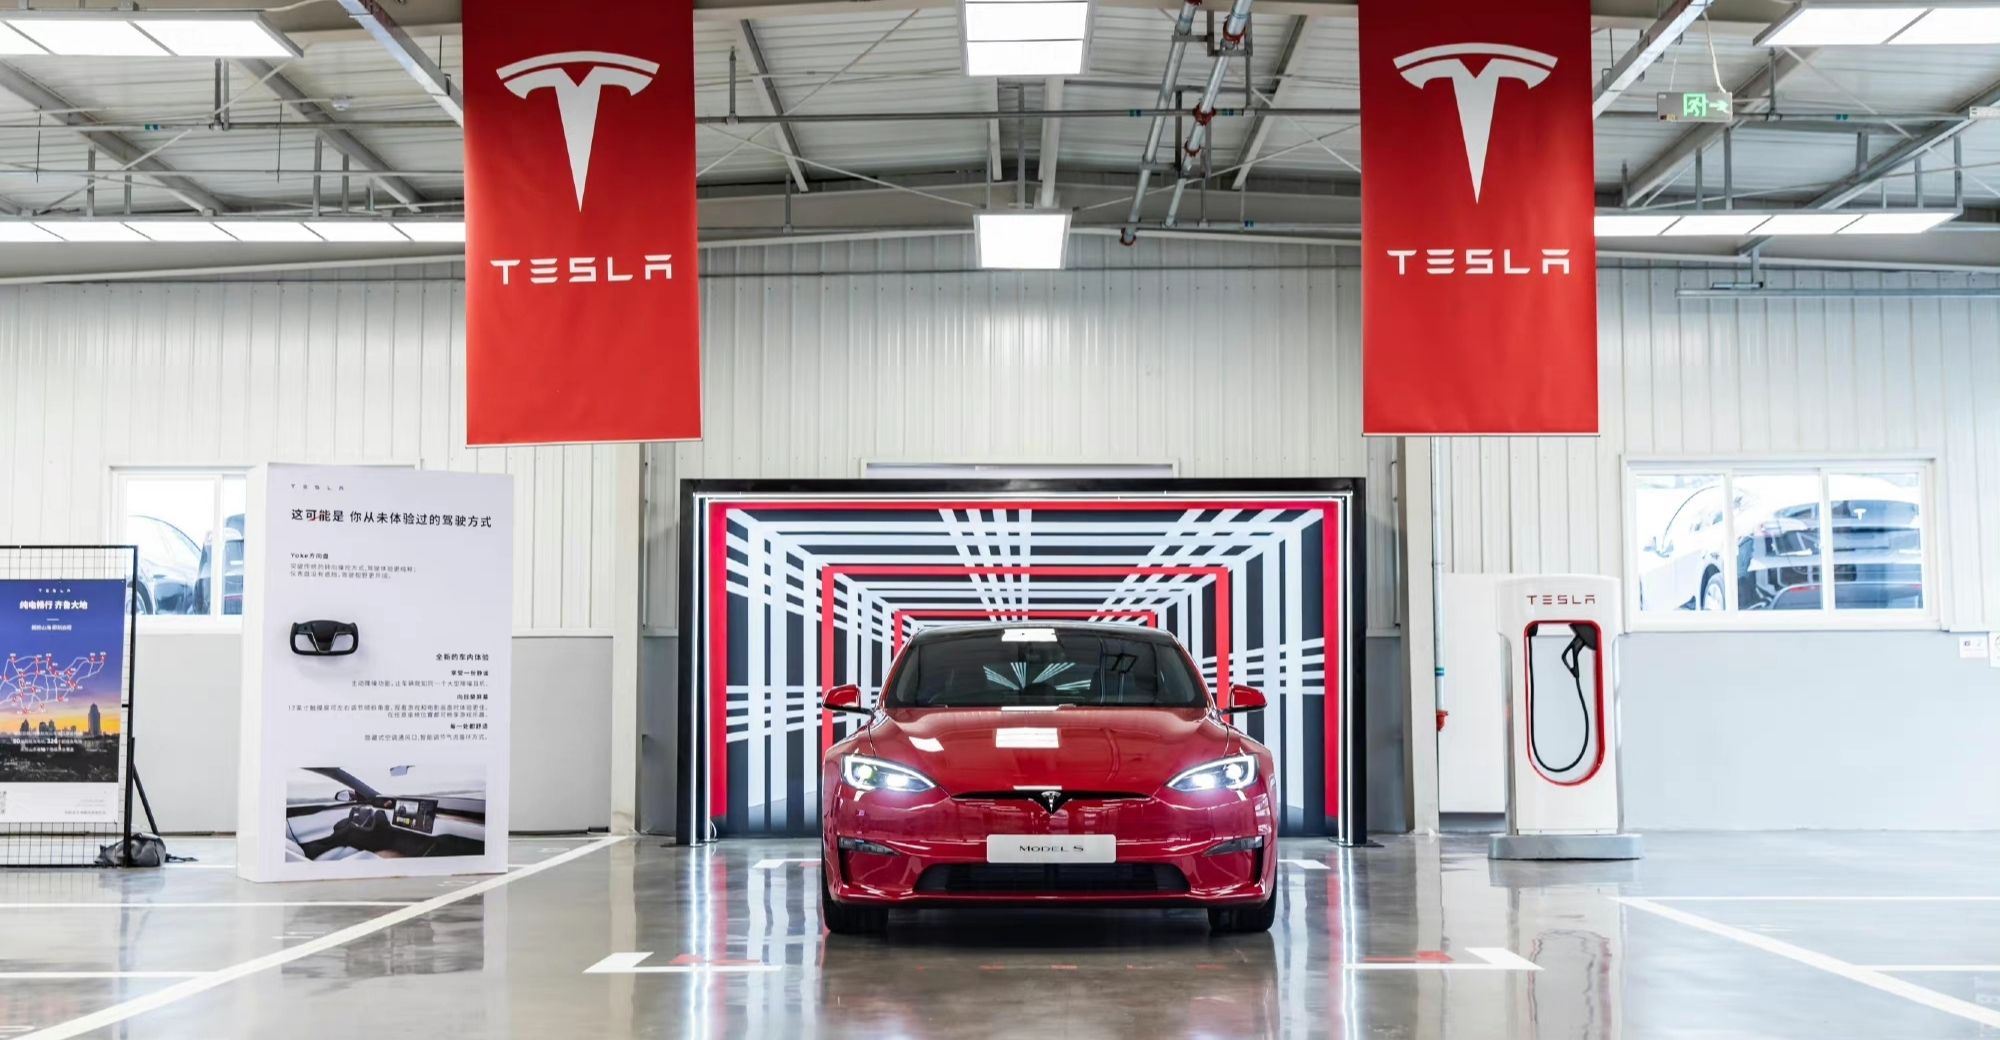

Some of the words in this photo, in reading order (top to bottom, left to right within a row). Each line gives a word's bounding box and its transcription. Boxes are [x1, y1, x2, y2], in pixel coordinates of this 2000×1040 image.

[490, 254, 672, 285] TESLA
[1387, 248, 1570, 275] TESLA
[291, 483, 345, 491] TESLA
[291, 508, 345, 523] 这可能是
[349, 511, 492, 528] 你从未体验过的驾驶方式
[1527, 594, 1596, 606] TESLA
[1019, 845, 1069, 853] MODEL
[1073, 845, 1084, 853] S
